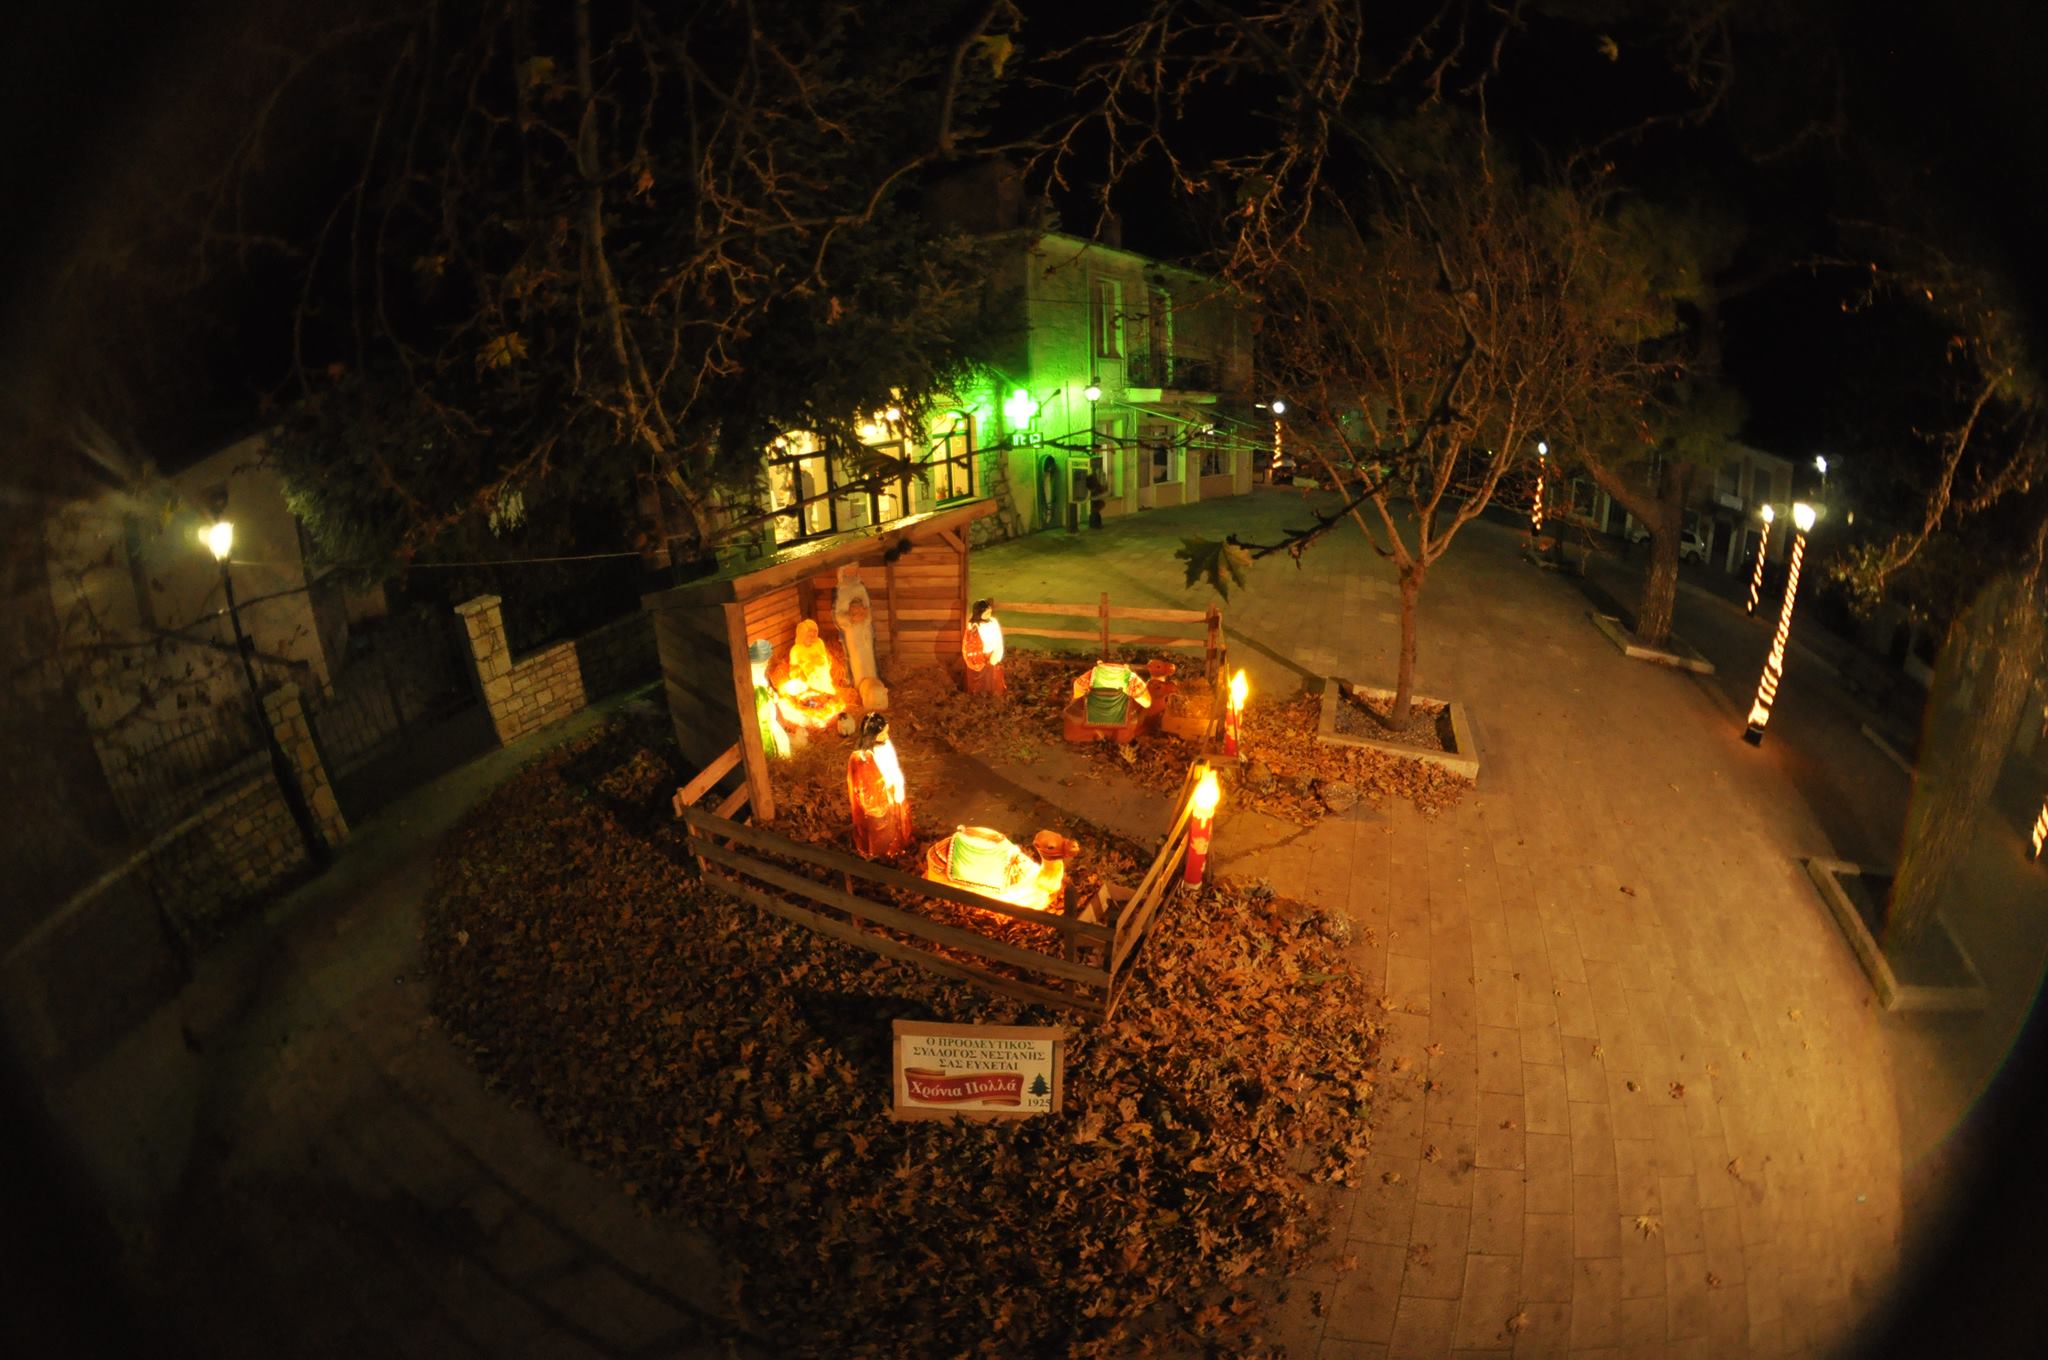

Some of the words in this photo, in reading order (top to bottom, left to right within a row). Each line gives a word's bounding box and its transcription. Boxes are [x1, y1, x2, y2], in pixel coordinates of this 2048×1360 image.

[926, 1037, 936, 1046] Ο
[939, 1038, 1035, 1050] ΠΡΟΟΔΕΥΤΙΚΟΣ
[913, 1046, 977, 1059] ΣΥΛΛΟΓΟΣ
[978, 1050, 1045, 1061] ΝΕΣΤΑΝΗΣ
[939, 1059, 963, 1069] ΣΑΣ
[966, 1060, 1018, 1071] ΕΥΧΕΤΑΙ
[911, 1080, 963, 1098] Χρόνια
[965, 1079, 1017, 1095] Πολλά
[1028, 1098, 1051, 1108] 1925
